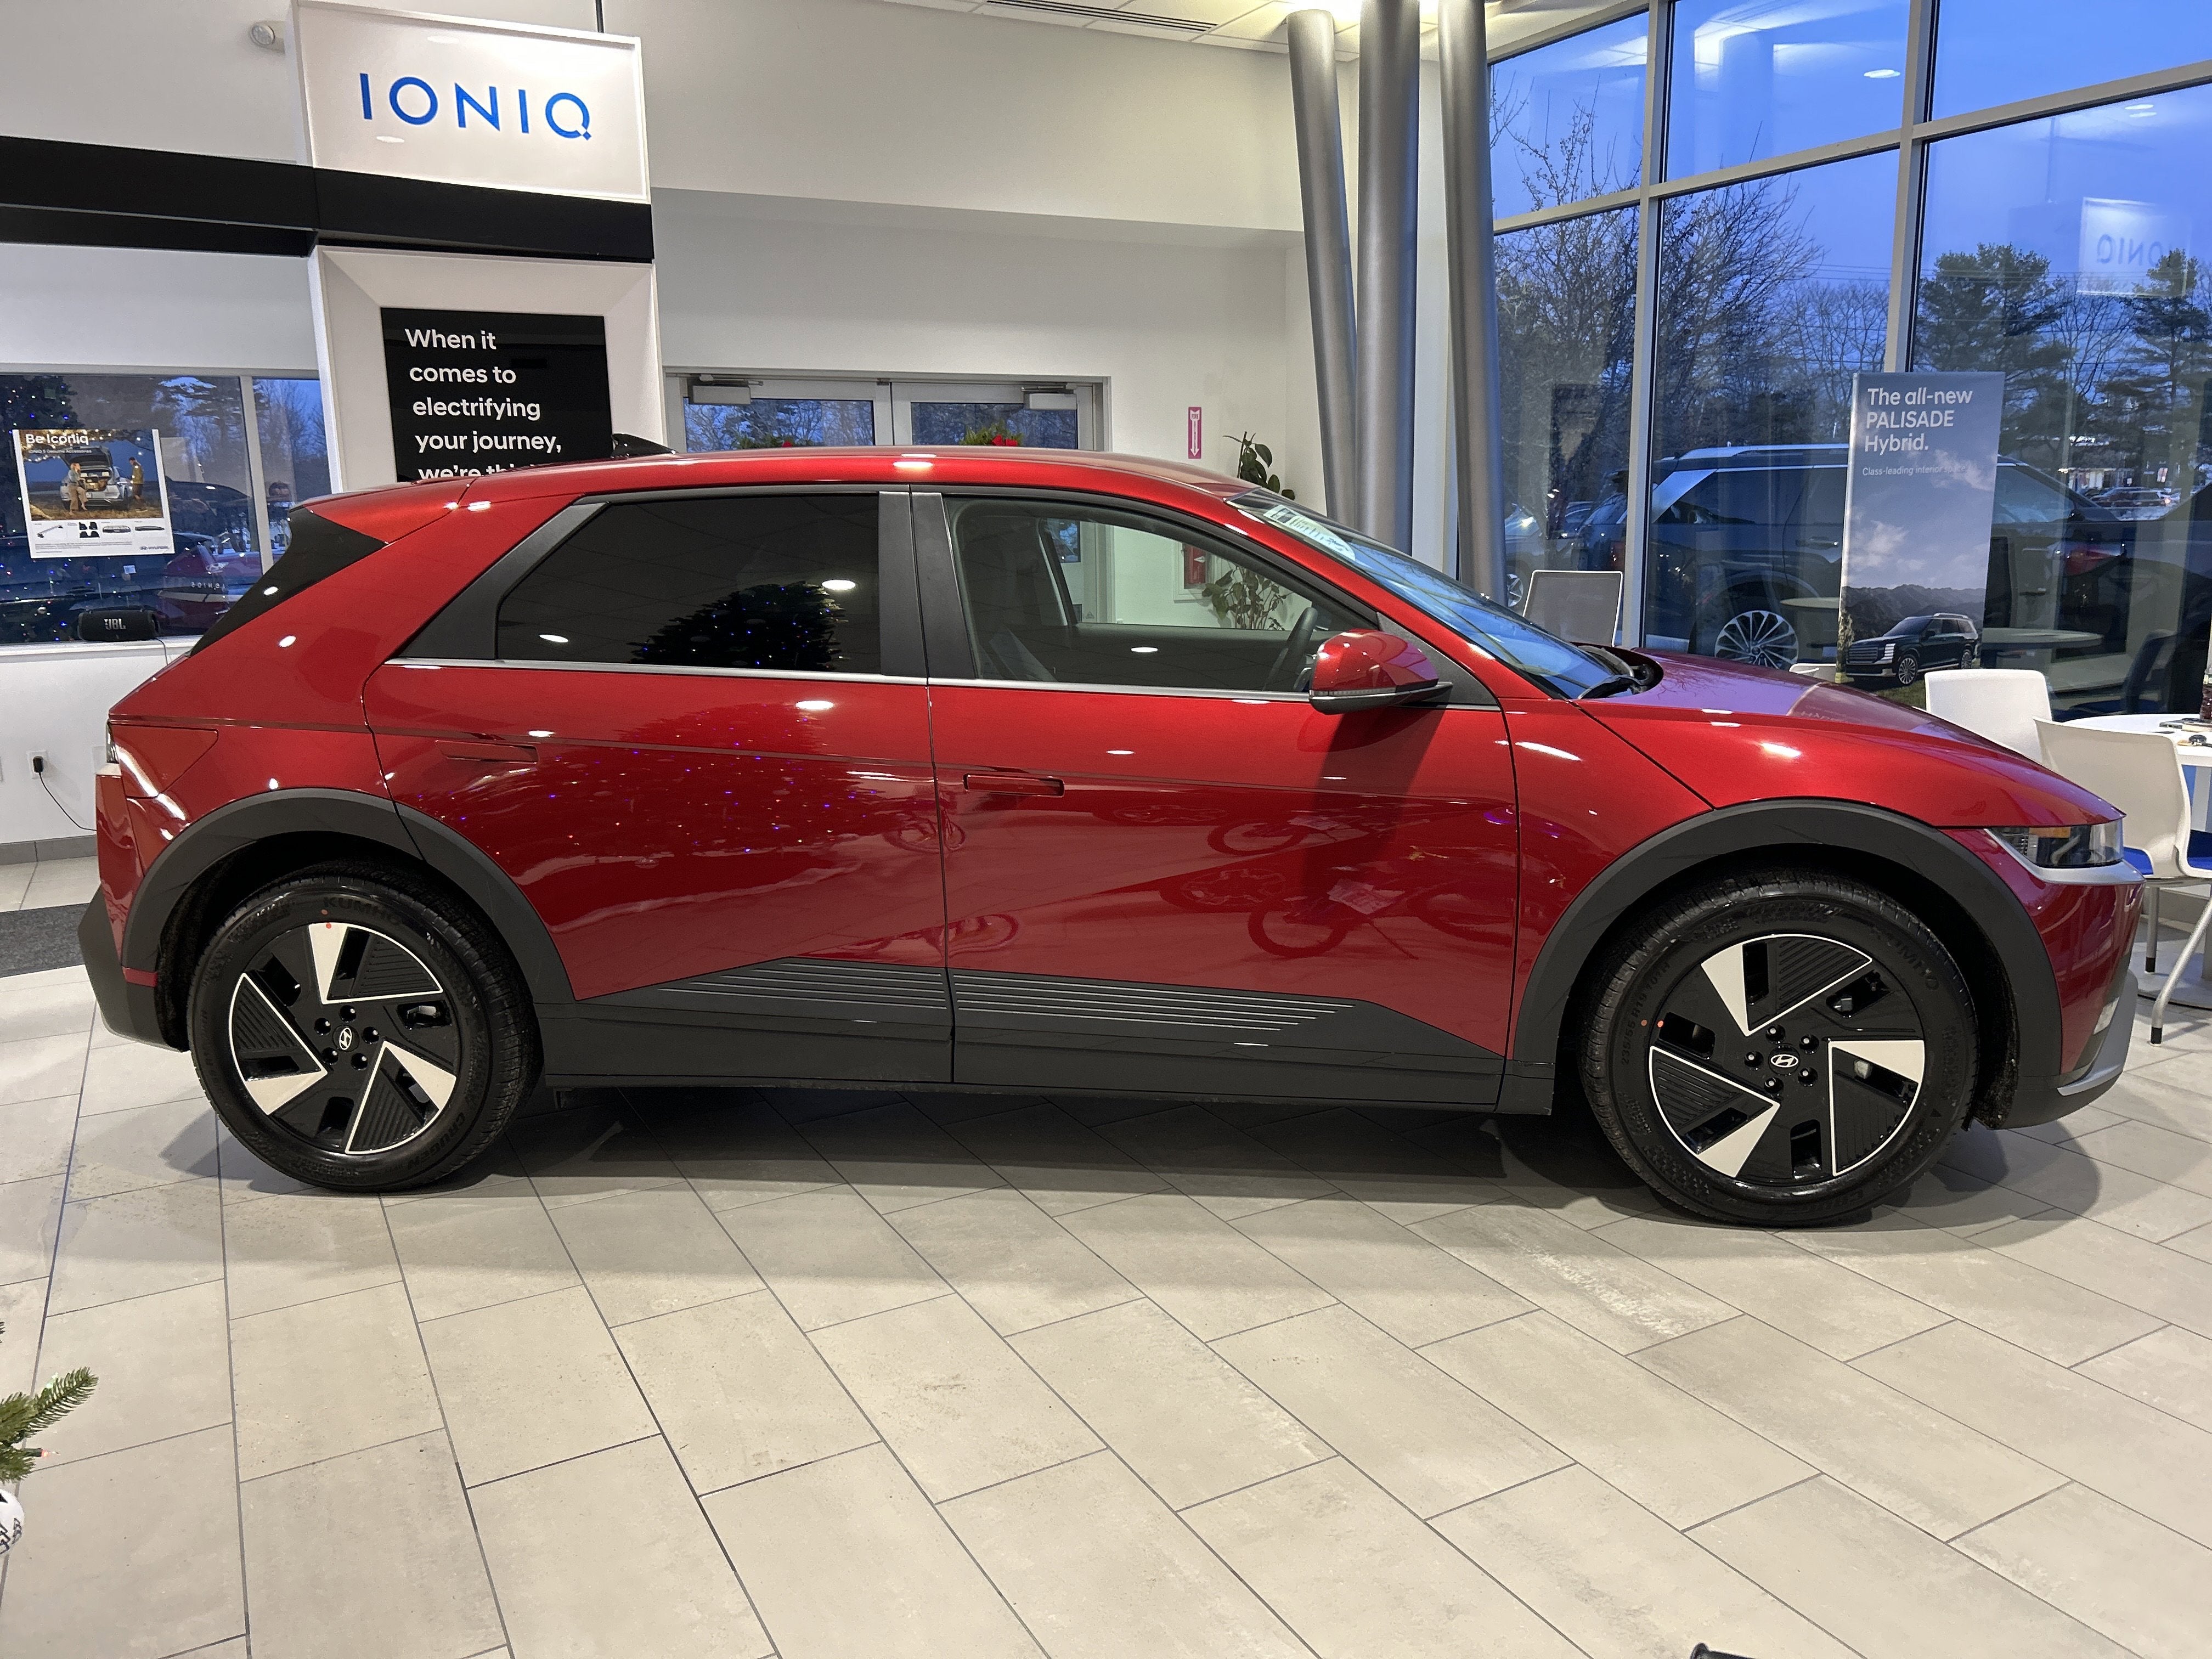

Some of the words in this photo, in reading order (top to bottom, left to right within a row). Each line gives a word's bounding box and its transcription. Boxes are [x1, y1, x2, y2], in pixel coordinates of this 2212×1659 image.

[360, 72, 592, 140] IONIQ
[405, 329, 476, 349] When
[481, 330, 496, 349] it
[409, 367, 488, 383] comes
[492, 366, 516, 383] to
[1868, 387, 1900, 405] The
[1905, 387, 1973, 405] all-new
[413, 397, 540, 421] electrifying
[1866, 410, 1954, 429] PALISADE
[25, 433, 44, 444] Be
[47, 433, 88, 445] Iconiq
[415, 435, 467, 453] your
[472, 430, 561, 453] journey,
[1865, 433, 1928, 455] Hybrid.
[1863, 467, 1913, 476] Class-leading
[1915, 466, 1944, 474] interior
[104, 618, 126, 630] JBL
